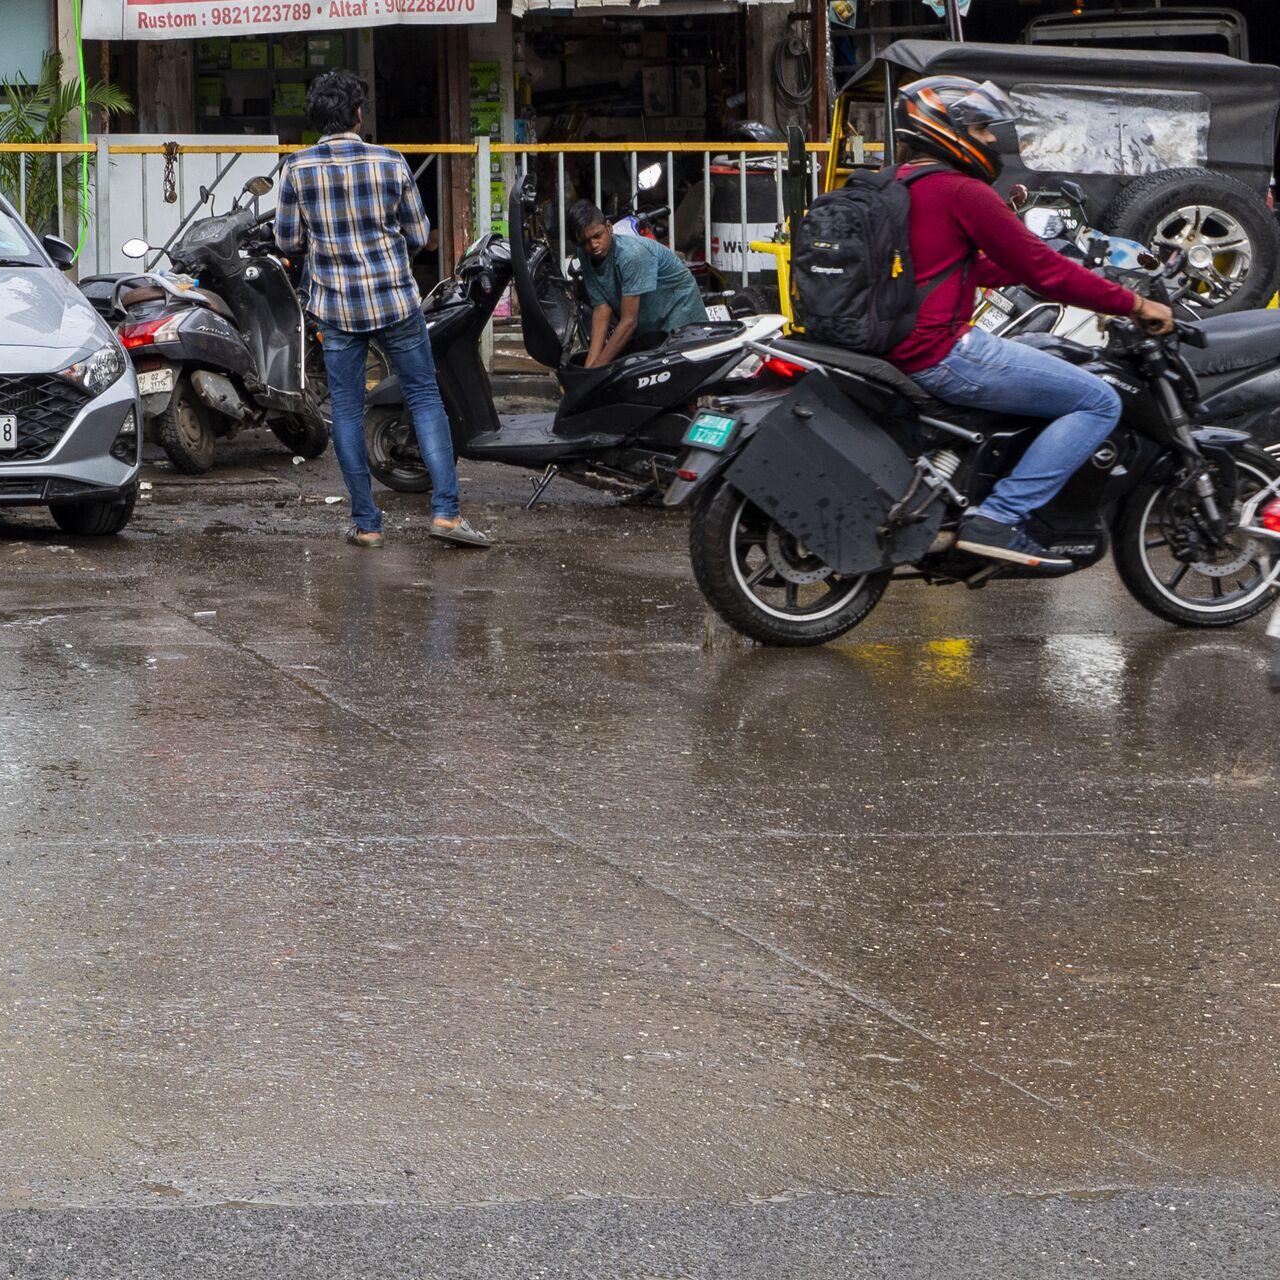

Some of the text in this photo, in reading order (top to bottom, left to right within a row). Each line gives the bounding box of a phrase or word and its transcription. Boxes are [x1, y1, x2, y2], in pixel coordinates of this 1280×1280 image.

[138, 11, 197, 29] Rustom
[212, 3, 311, 25] 9821223789
[329, 0, 368, 18] Altaf
[637, 371, 671, 389] DIO
